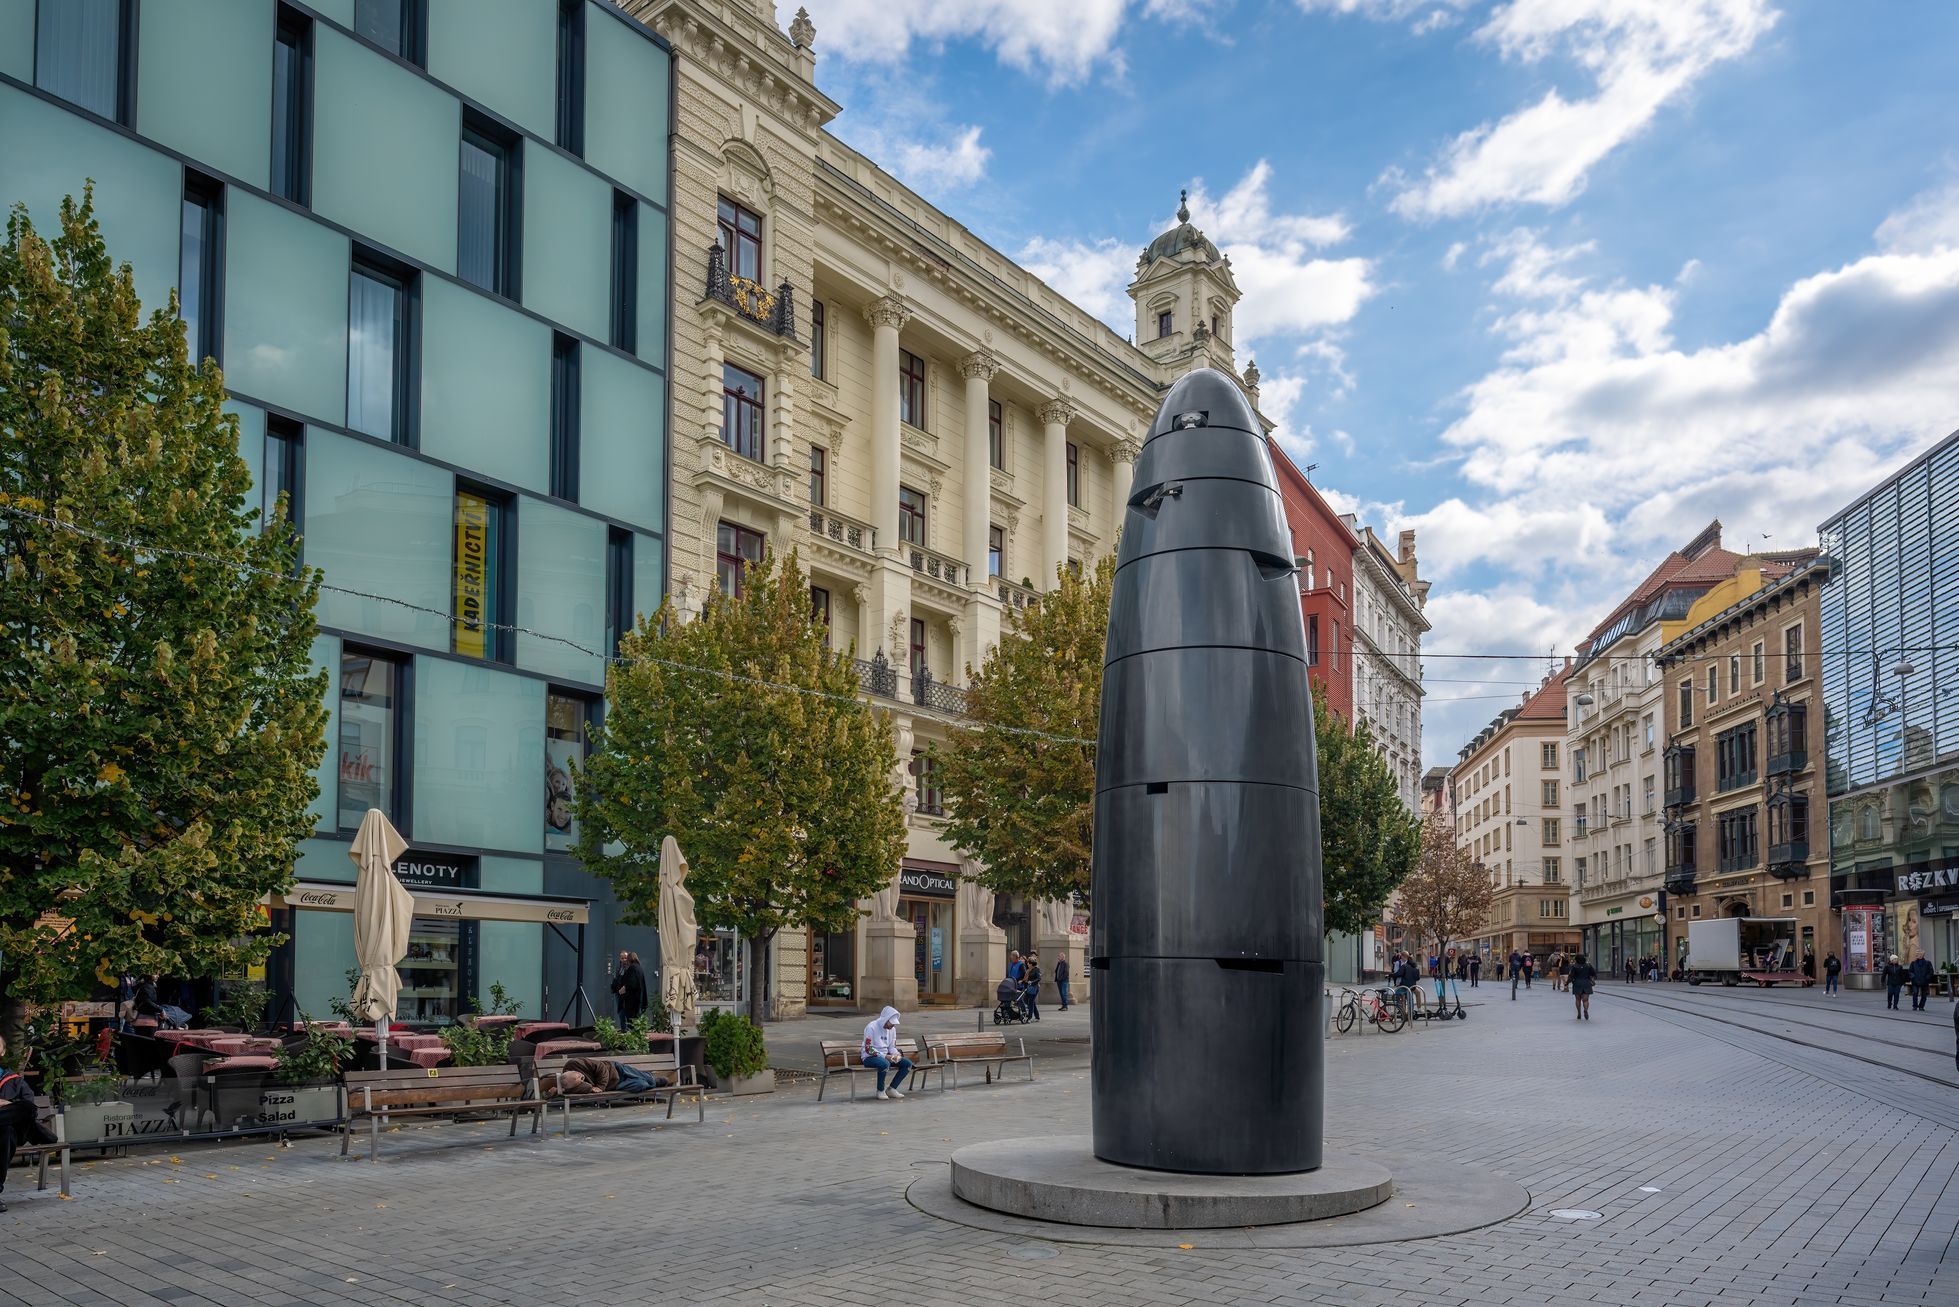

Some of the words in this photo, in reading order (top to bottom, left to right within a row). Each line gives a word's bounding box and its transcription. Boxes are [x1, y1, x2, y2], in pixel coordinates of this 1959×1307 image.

[460, 510, 482, 633] KADEŘNICTVÍ
[391, 861, 458, 879] ENOTY
[899, 874, 954, 890] ANDOPTICAL
[259, 1094, 295, 1106] Pizza
[103, 1113, 144, 1122] Ristorante
[258, 1110, 296, 1123] Salad
[104, 1119, 180, 1137] PIAZZA
